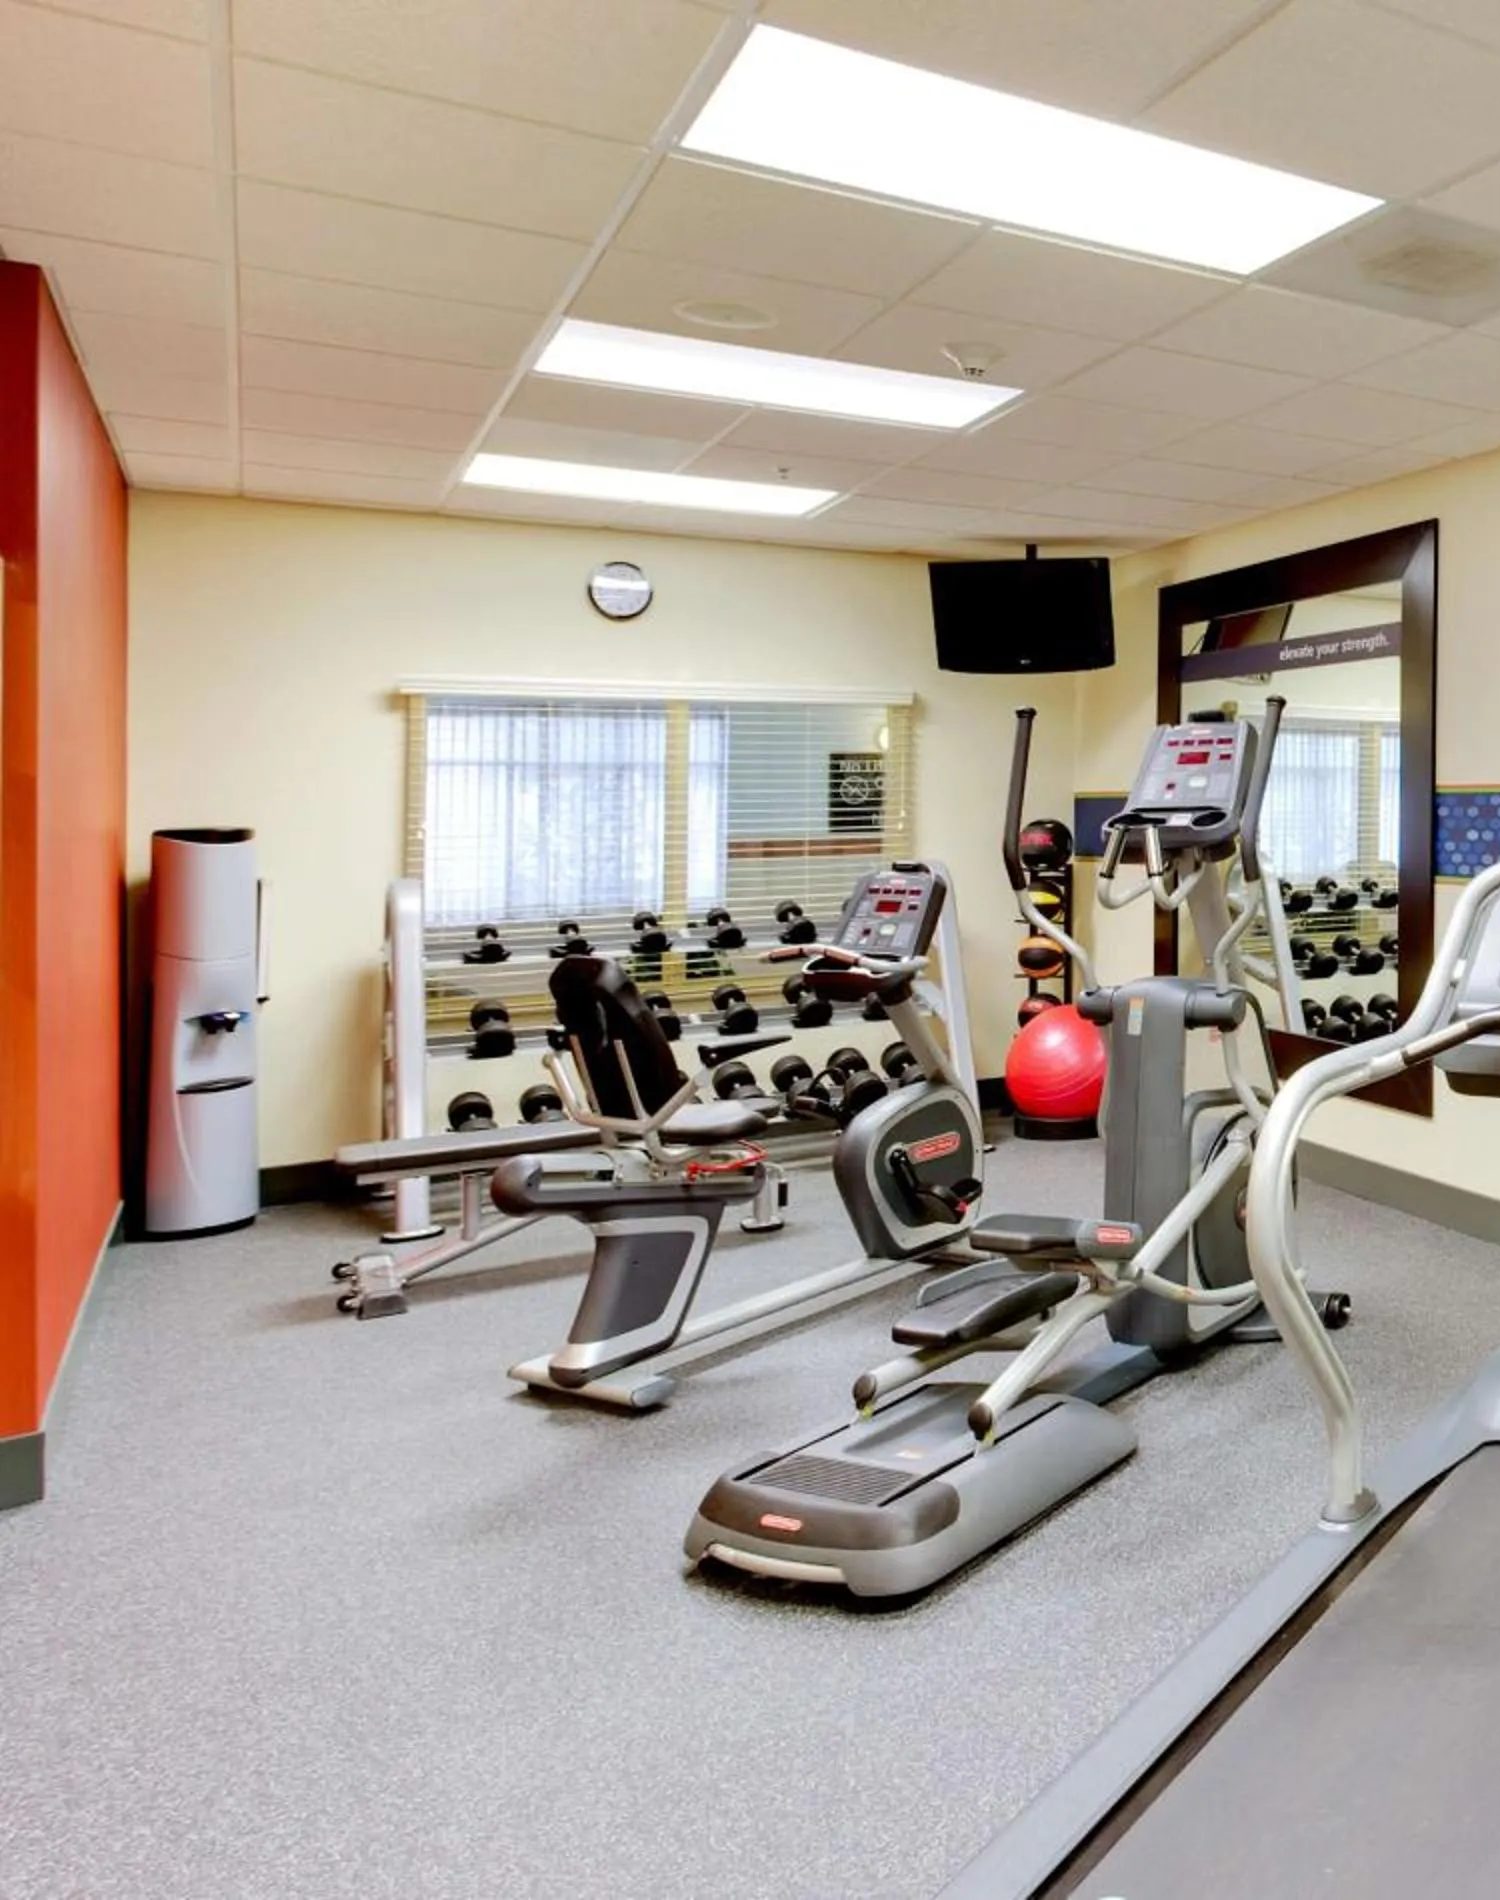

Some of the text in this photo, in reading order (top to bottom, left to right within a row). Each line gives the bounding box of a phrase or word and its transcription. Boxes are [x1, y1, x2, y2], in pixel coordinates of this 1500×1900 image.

[1280, 632, 1390, 661] elevate your strength.
